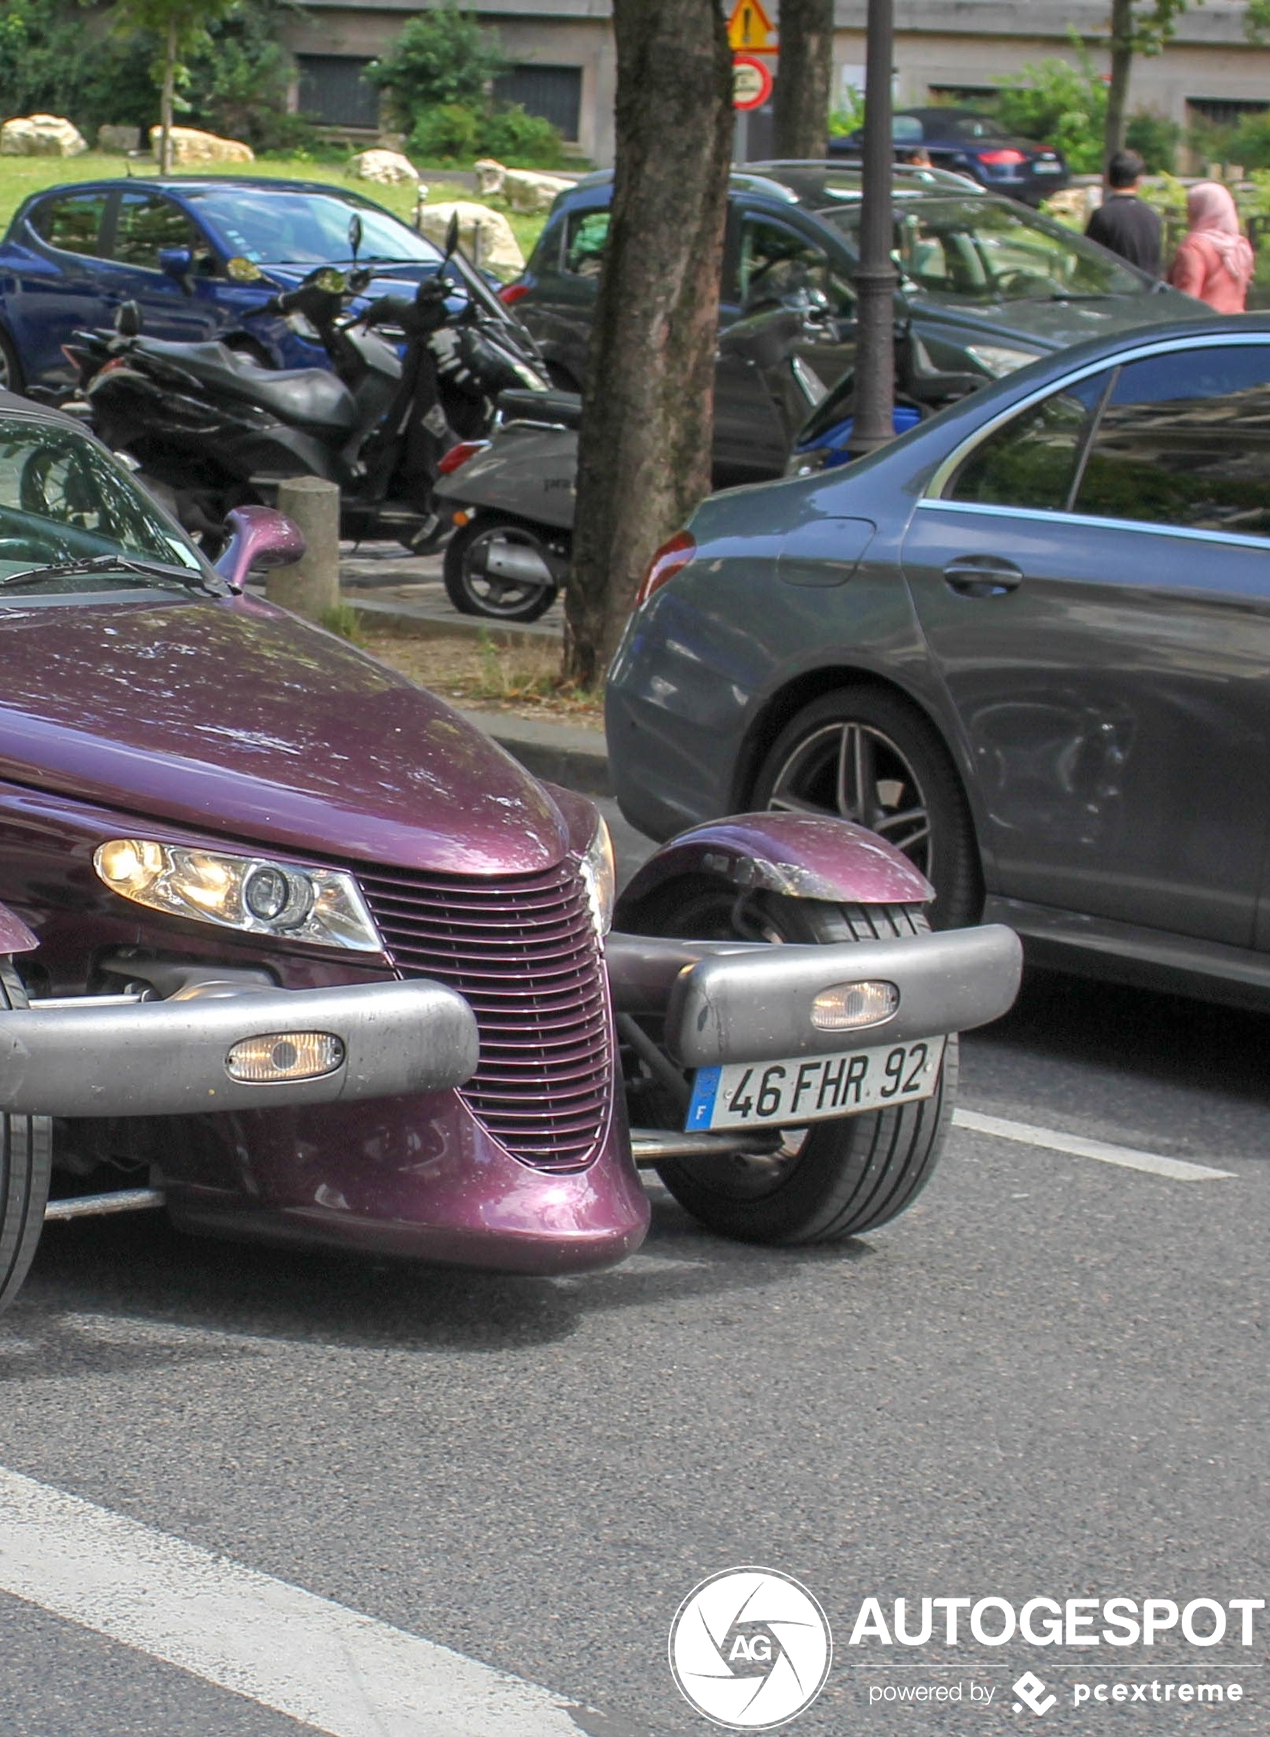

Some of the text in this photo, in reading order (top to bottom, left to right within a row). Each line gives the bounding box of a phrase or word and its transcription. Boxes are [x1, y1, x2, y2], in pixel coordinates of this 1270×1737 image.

[727, 1065, 787, 1119] 46
[790, 1054, 870, 1114] FHR
[880, 1042, 929, 1099] 92
